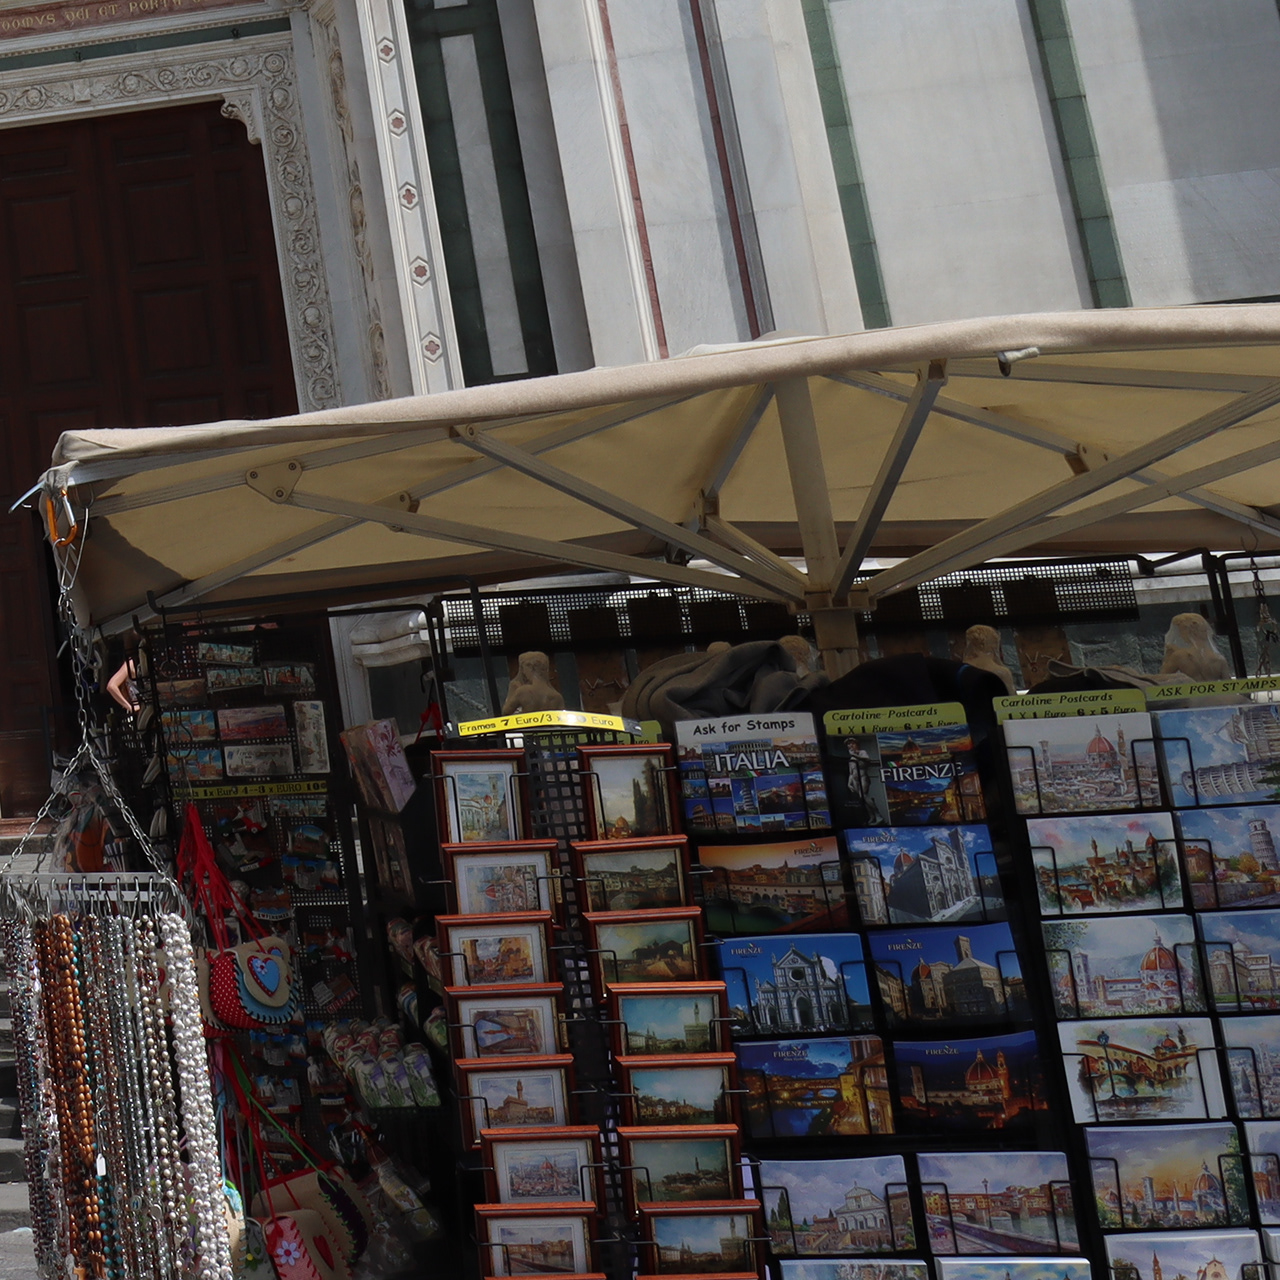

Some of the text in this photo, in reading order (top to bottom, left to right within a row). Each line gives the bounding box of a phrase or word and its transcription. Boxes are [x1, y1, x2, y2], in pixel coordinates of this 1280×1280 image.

[99, 3, 120, 17] ET
[1156, 687, 1182, 697] ASK
[1189, 684, 1215, 694] FOR
[1113, 706, 1136, 714] Euro
[459, 721, 496, 733] Frames
[501, 718, 510, 727] 7
[591, 716, 614, 726] Euro
[693, 718, 795, 736] Ask for Stamps
[713, 749, 790, 773] ITALIA
[880, 762, 965, 783] FIRENZE
[276, 783, 302, 793] EURO
[862, 835, 897, 844] FIRENZE
[793, 846, 824, 856] FIRENZE
[730, 946, 763, 956] FIRENZE
[888, 942, 923, 951] FIRENZE
[773, 1050, 808, 1059] FIRENZE
[926, 1048, 960, 1056] FIRENZE
